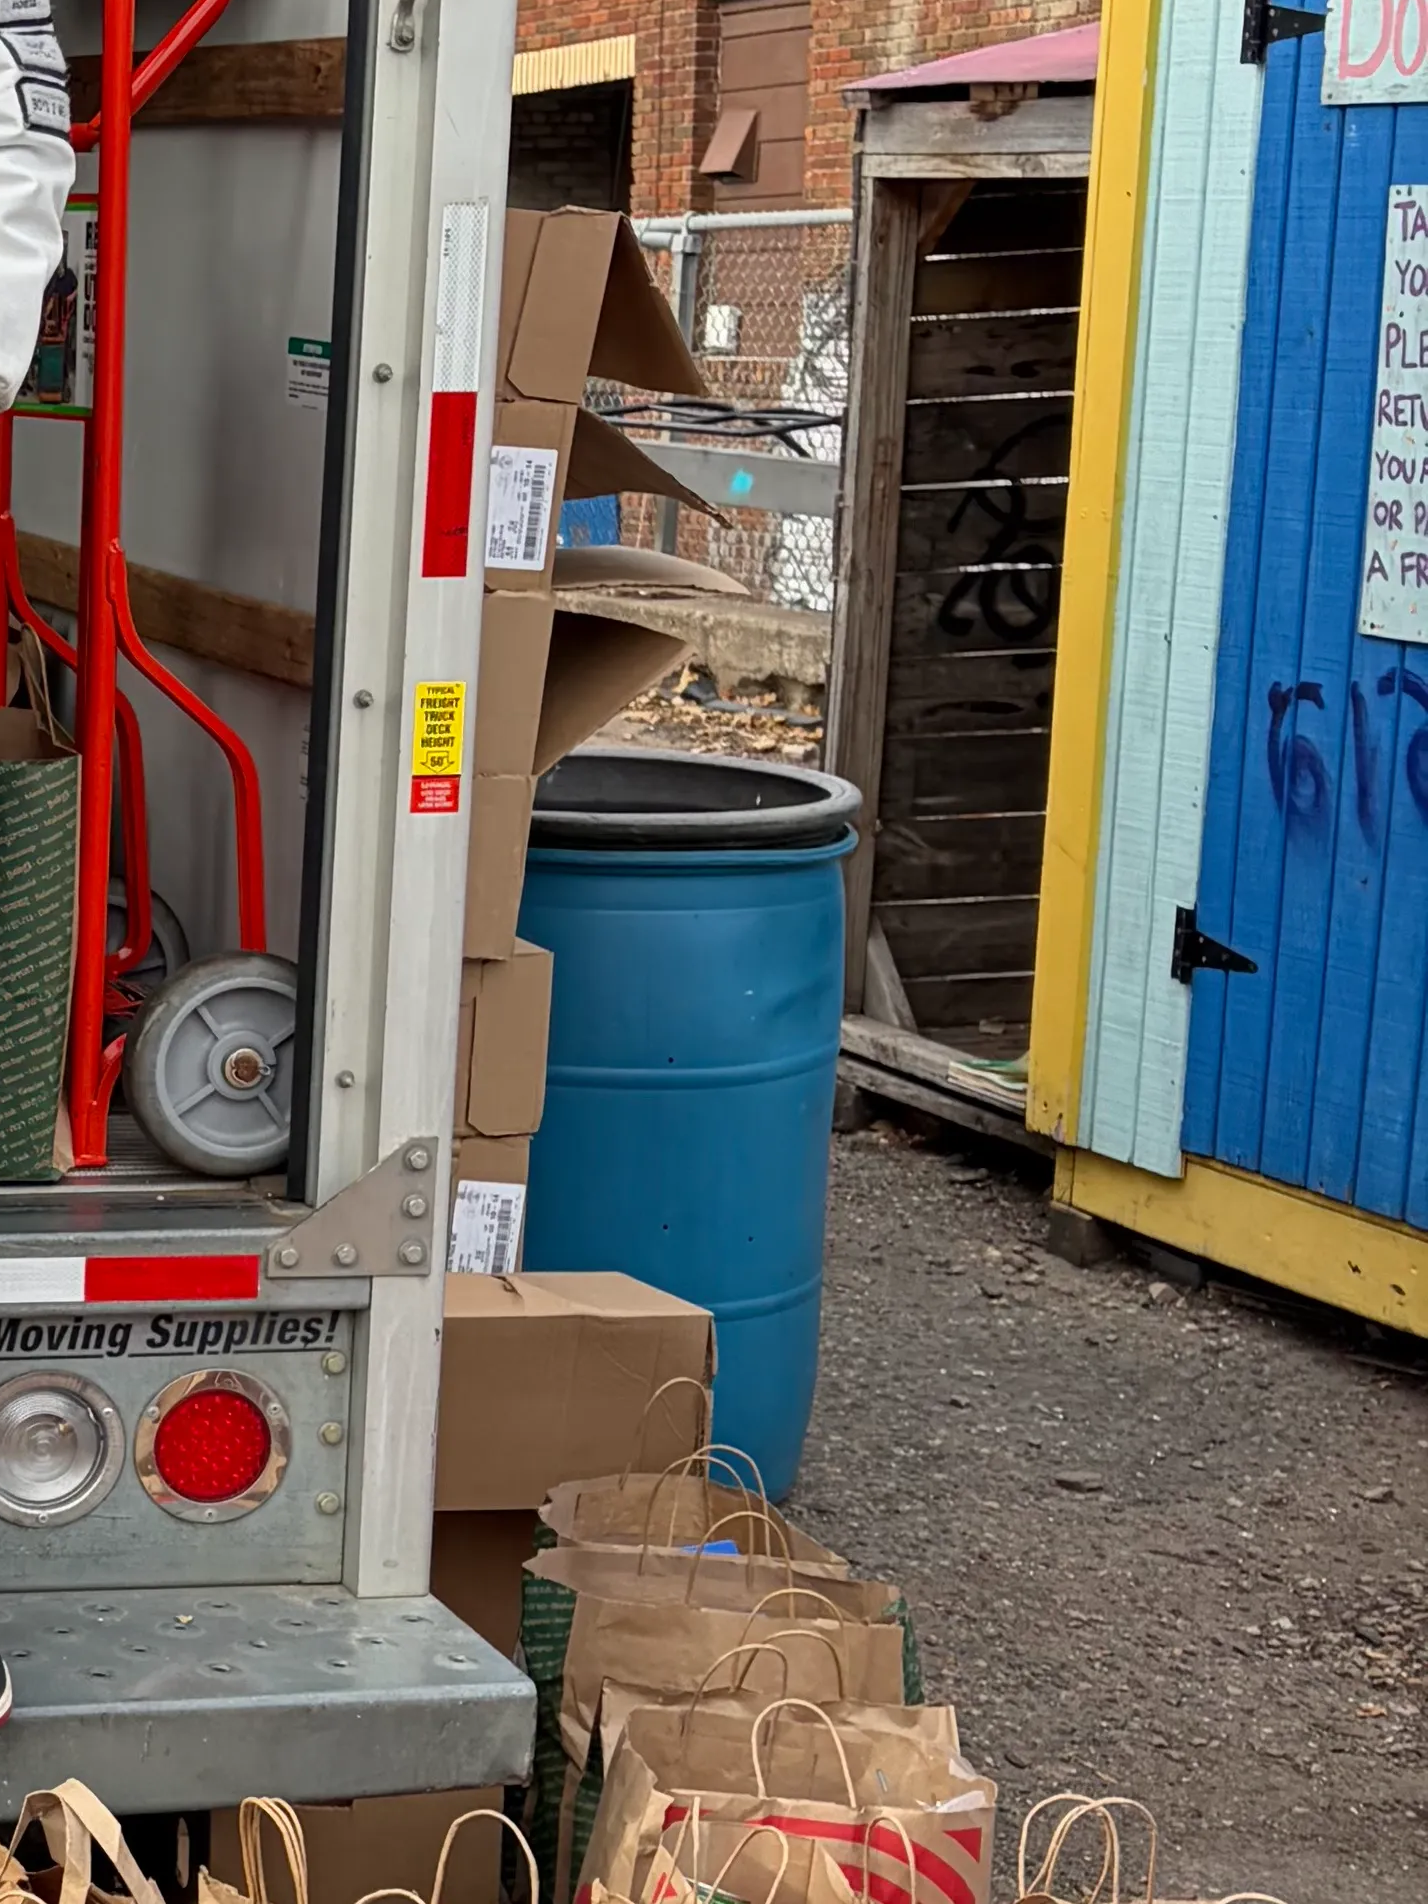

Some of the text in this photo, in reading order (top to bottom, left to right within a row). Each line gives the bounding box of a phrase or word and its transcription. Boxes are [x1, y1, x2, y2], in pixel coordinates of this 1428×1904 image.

[1374, 501, 1403, 531] OR
[1366, 548, 1388, 582] A
[420, 698, 460, 708] FREIGHT
[425, 711, 455, 721] TRUCK
[426, 724, 451, 734] DECK
[421, 737, 455, 748] HEIGHT
[146, 1310, 339, 1352] Supplies!
